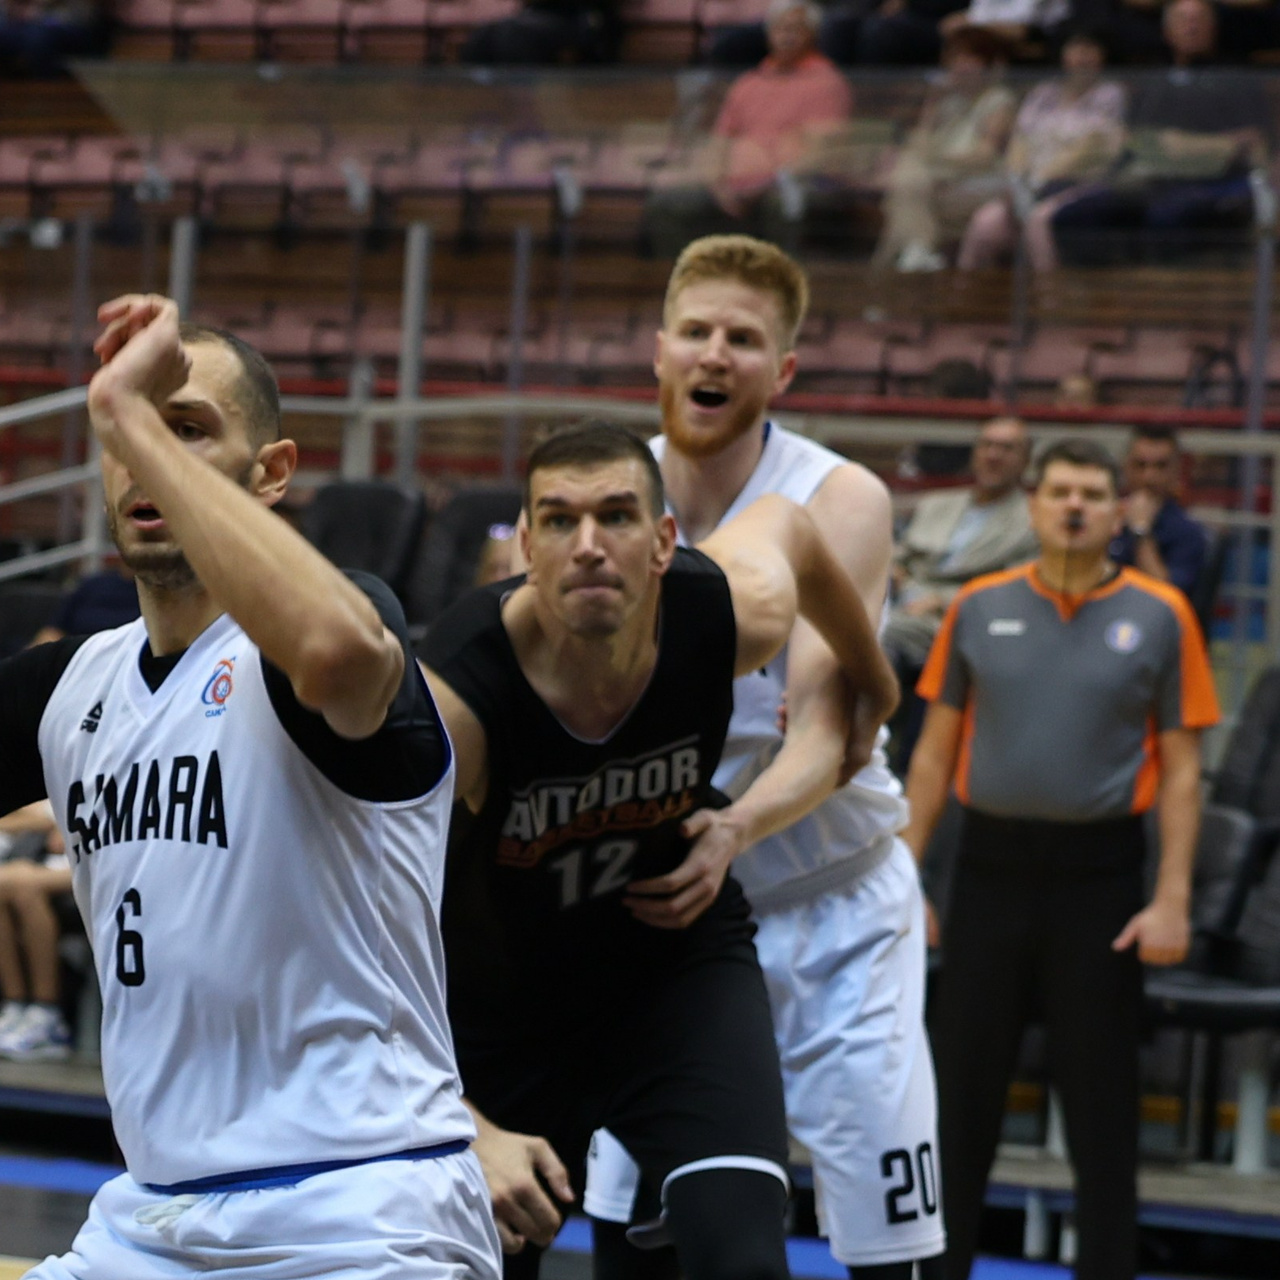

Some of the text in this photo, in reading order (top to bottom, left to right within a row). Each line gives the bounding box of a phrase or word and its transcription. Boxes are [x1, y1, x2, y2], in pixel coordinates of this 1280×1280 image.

[501, 747, 700, 842] AVTODOR
[550, 838, 639, 909] 12
[115, 887, 146, 987] 6
[881, 1142, 937, 1225] 20
